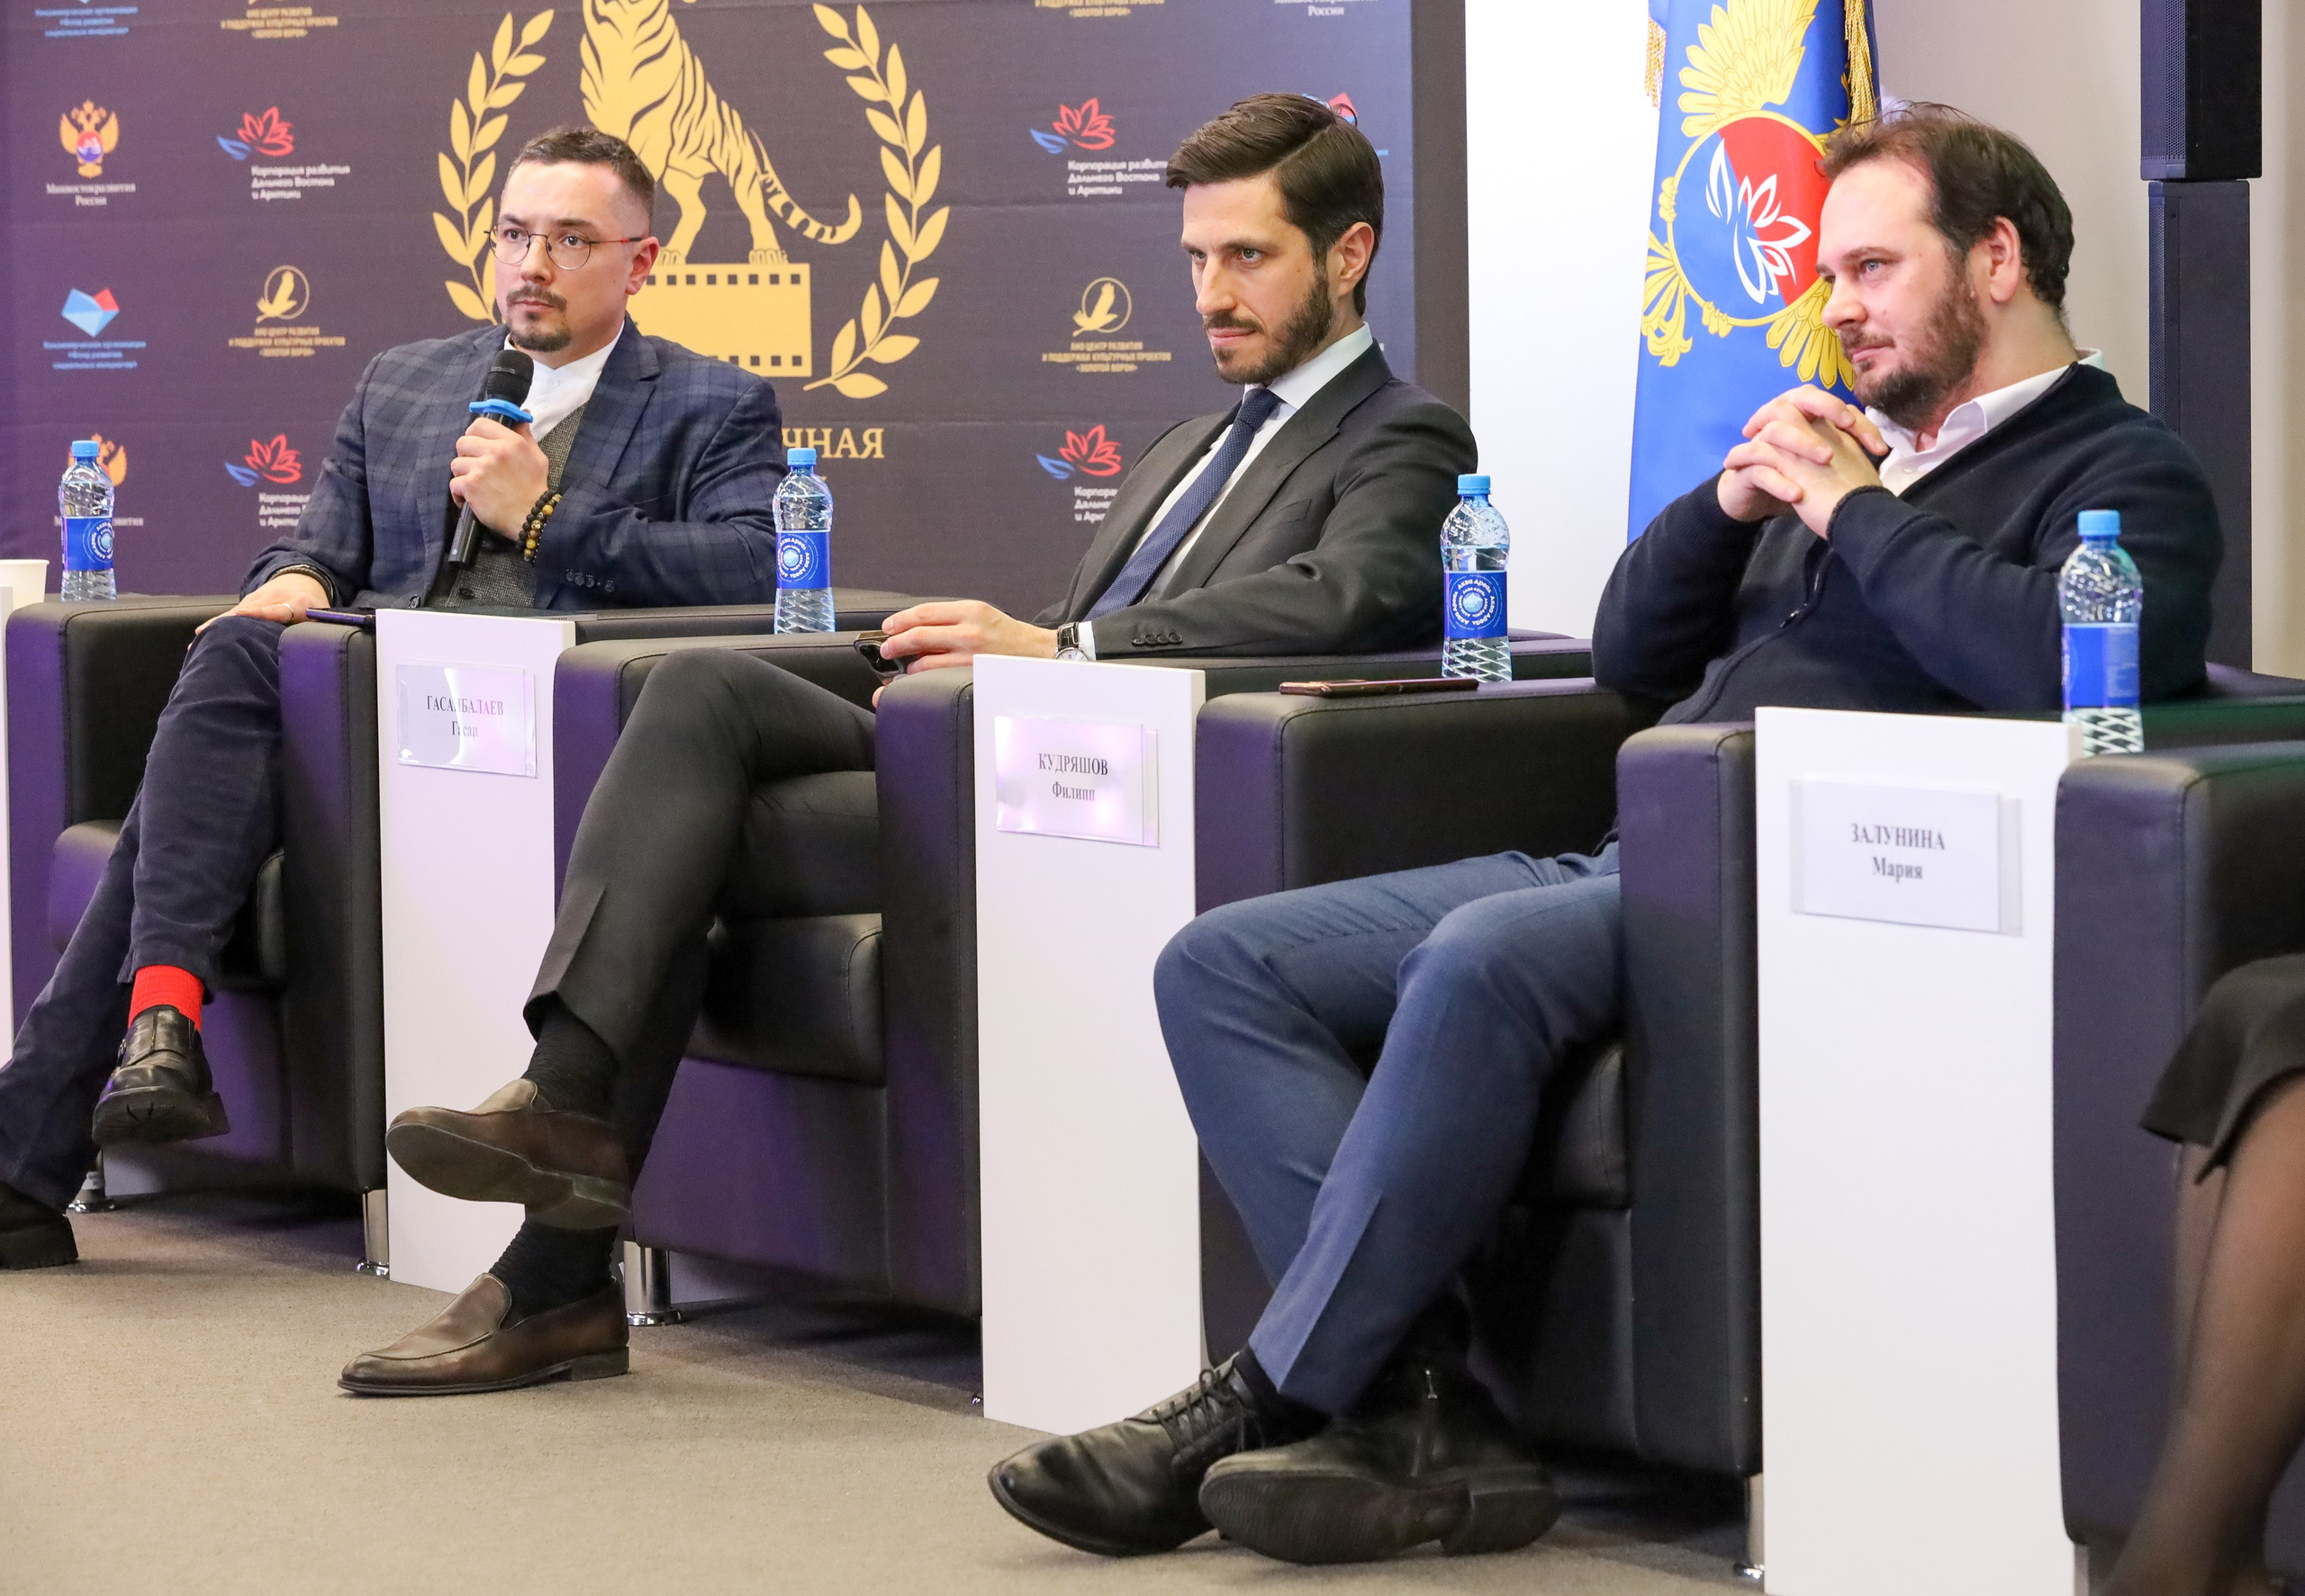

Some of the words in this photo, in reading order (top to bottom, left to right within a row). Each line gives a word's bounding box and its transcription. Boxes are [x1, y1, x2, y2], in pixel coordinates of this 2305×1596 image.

[1074, 486, 1119, 499] Корпора
[1038, 753, 1108, 776] КУДРЯШОВ
[1052, 780, 1096, 801] Филипп
[1850, 823, 1946, 851] ЗАЛУНИНА
[1872, 856, 1924, 883] Мария
